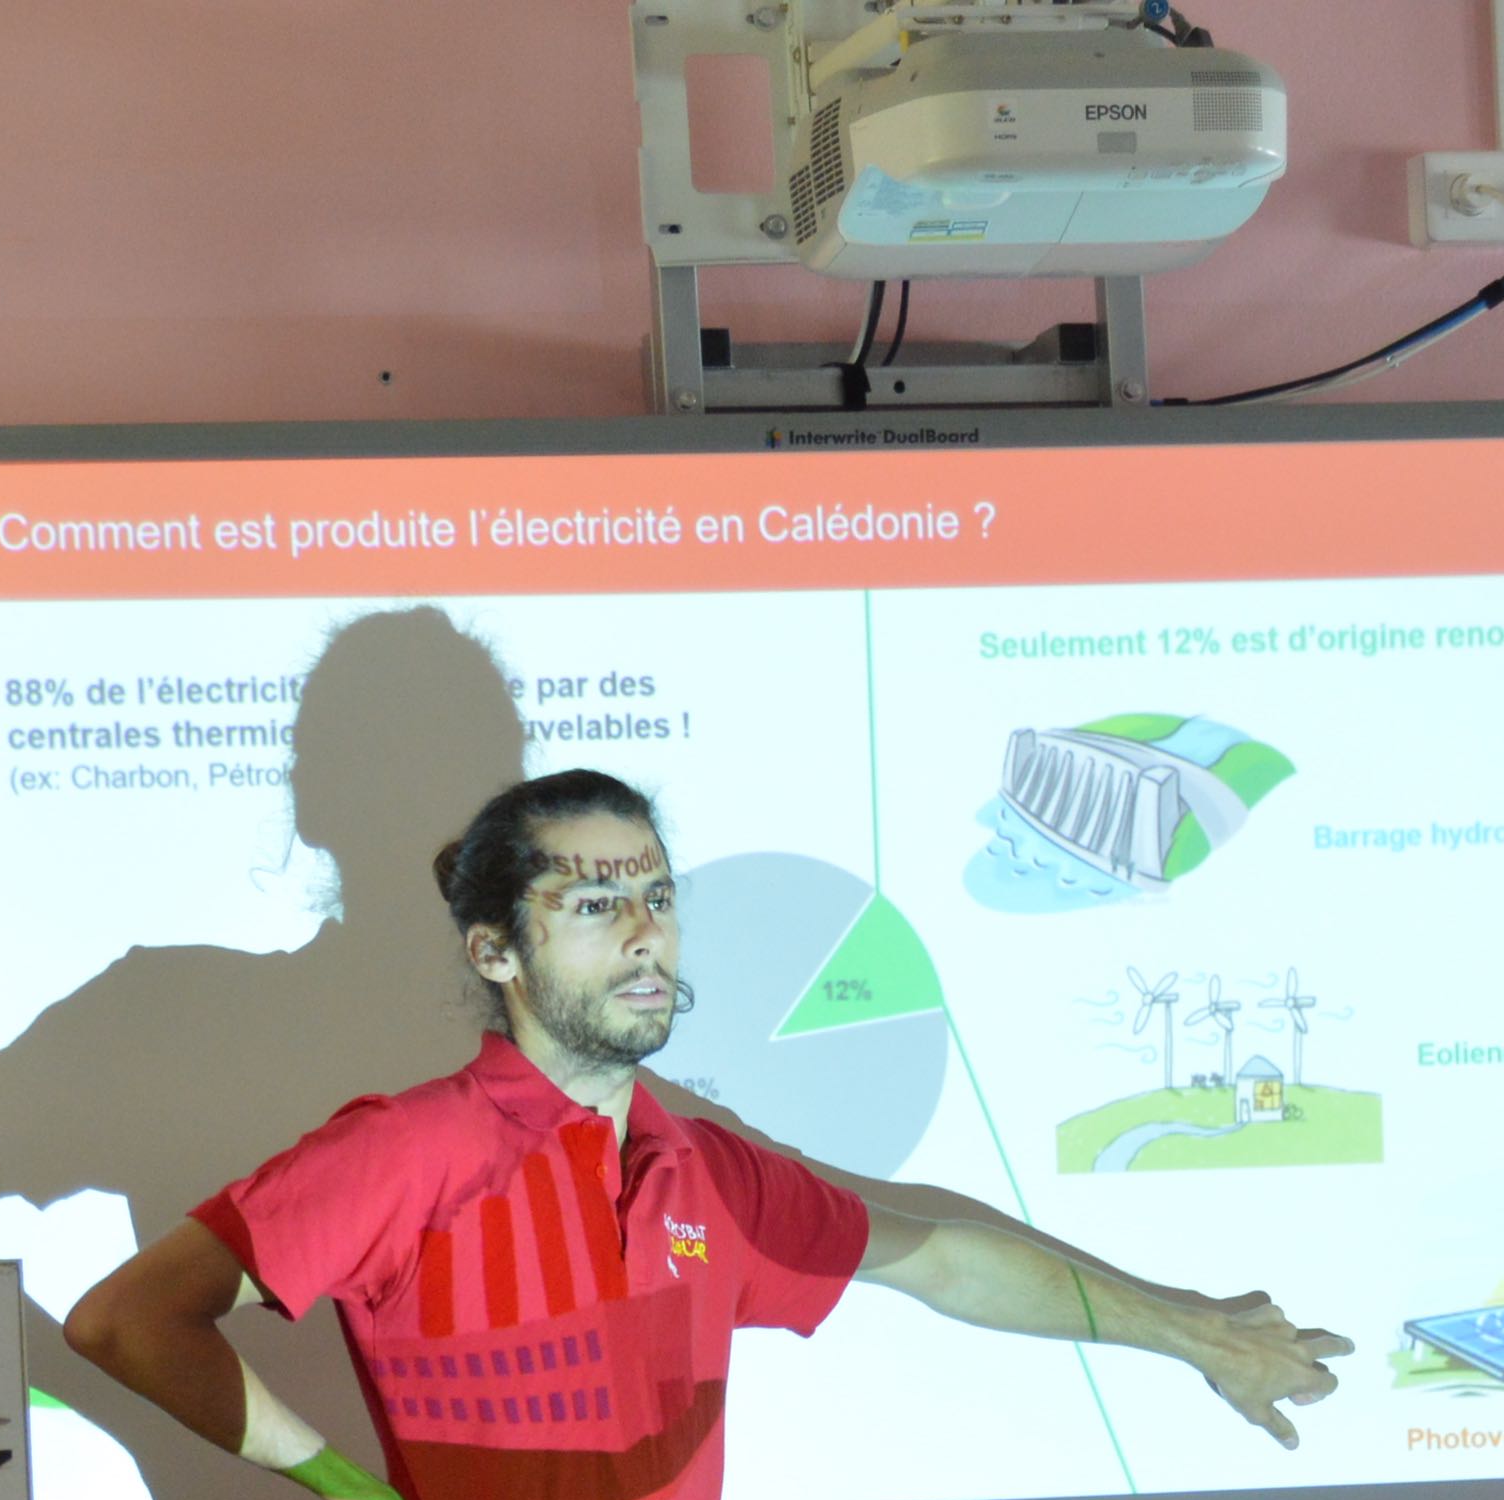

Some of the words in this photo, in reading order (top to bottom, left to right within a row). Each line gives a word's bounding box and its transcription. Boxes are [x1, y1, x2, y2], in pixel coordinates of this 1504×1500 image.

[1085, 104, 1147, 122] EPSON
[789, 429, 876, 447] Interwrite
[883, 428, 979, 446] DualBoard
[215, 514, 277, 549] est
[291, 511, 456, 557] produite
[469, 506, 682, 547] l'électricité
[696, 513, 744, 543] en
[759, 504, 959, 543] Calédonie
[974, 502, 996, 540] ?
[980, 631, 1147, 659] Seulement
[1158, 626, 1220, 656] 12%
[1231, 628, 1279, 654] est
[1288, 621, 1426, 659] d'origine
[5, 678, 74, 707] 88%
[86, 675, 125, 705] de
[137, 674, 305, 705] l'électricit
[537, 676, 588, 705] par
[599, 671, 656, 699] des
[8, 720, 161, 751] centrales
[682, 712, 691, 738] !
[10, 766, 61, 792] (ex:
[71, 763, 198, 792] Charbon,
[209, 761, 294, 788] Pétrol
[1314, 823, 1422, 854] Barrage
[823, 980, 872, 1003] 12%
